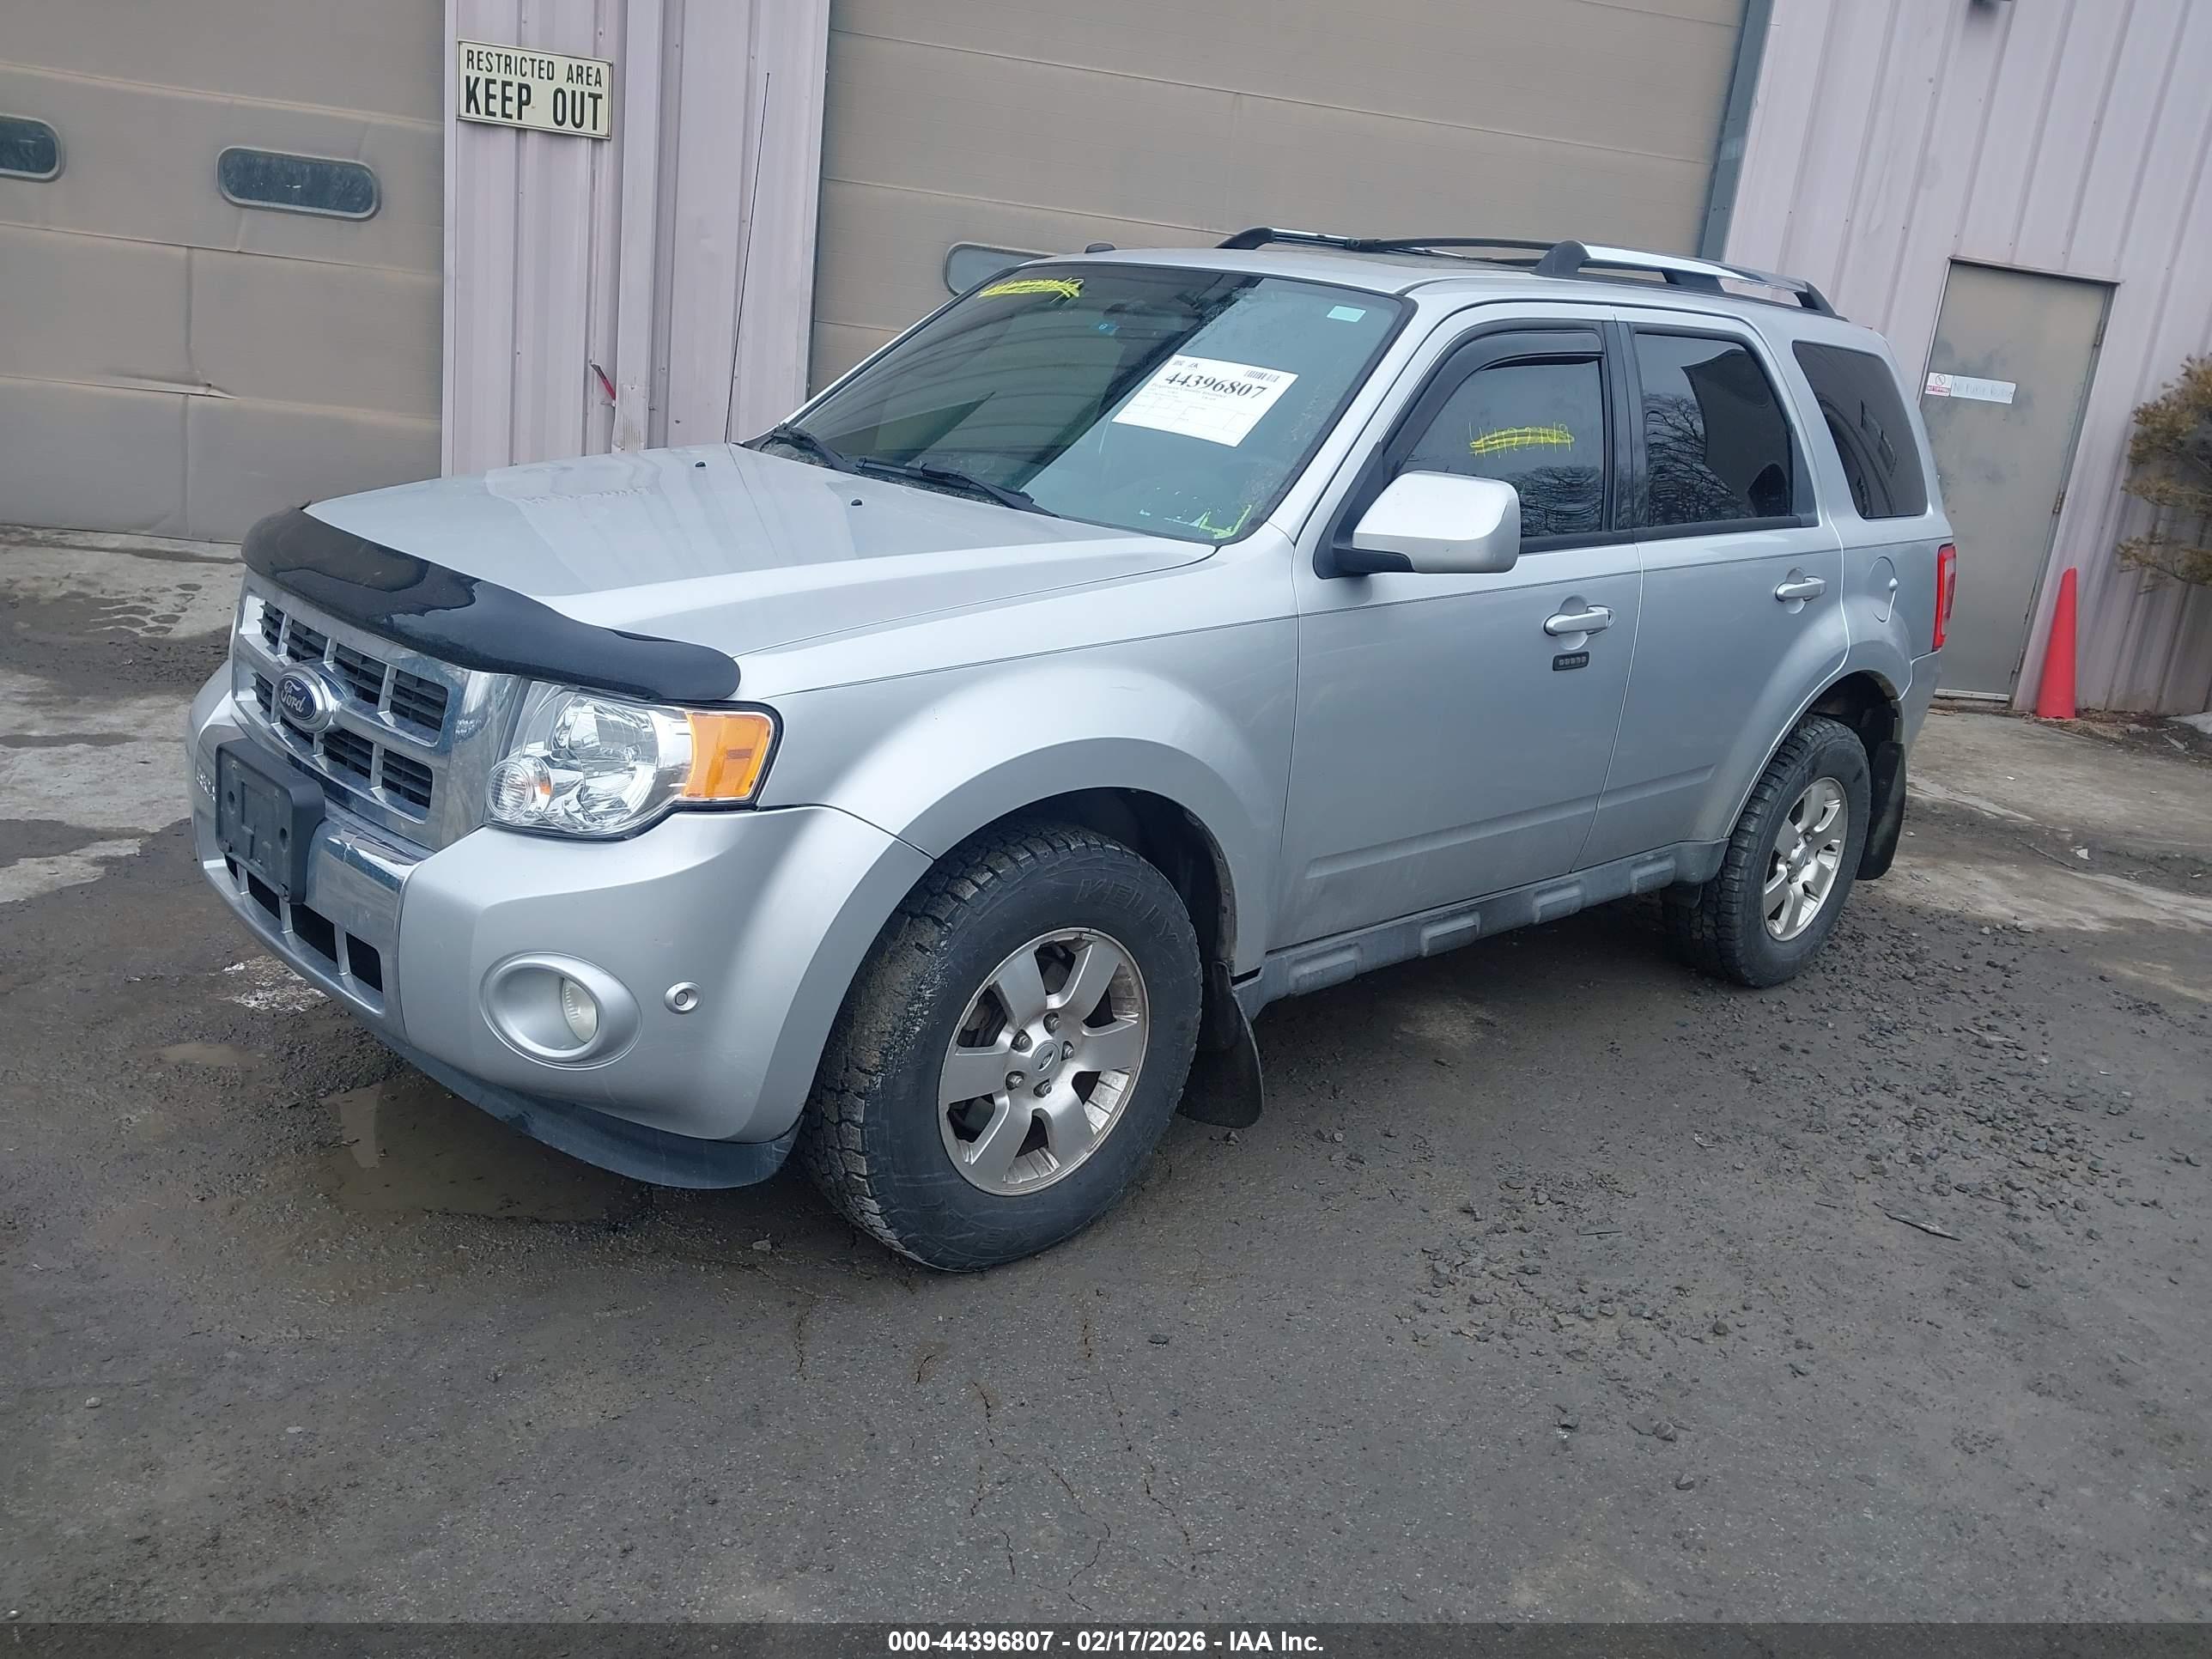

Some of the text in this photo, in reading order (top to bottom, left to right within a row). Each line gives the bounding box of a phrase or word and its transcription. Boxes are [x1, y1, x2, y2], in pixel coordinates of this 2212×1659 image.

[466, 49, 603, 88] RESTRICTED AREA
[465, 75, 603, 131] KEEP OUT
[1164, 371, 1268, 398] 44396807
[281, 680, 307, 713] Ford
